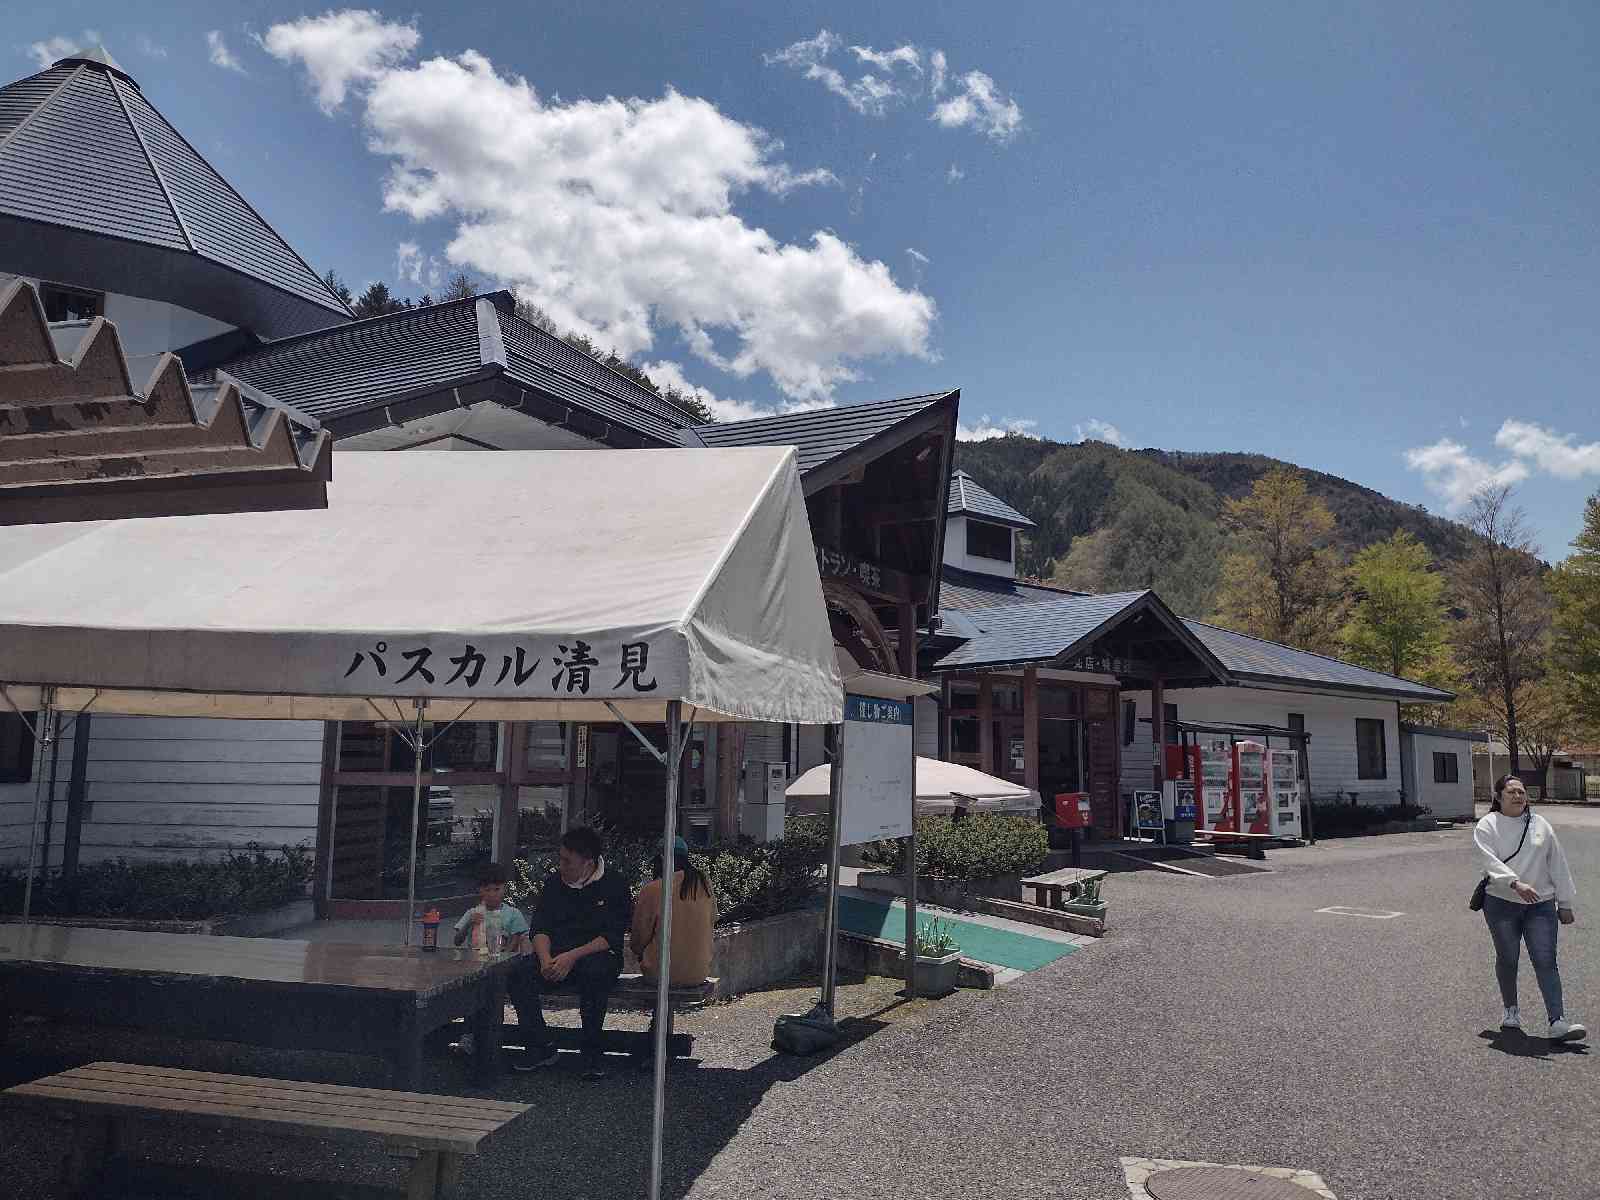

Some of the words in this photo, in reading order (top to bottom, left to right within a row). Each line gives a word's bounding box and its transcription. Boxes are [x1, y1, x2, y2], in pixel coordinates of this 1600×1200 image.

[343, 640, 658, 695] パスカル清見
